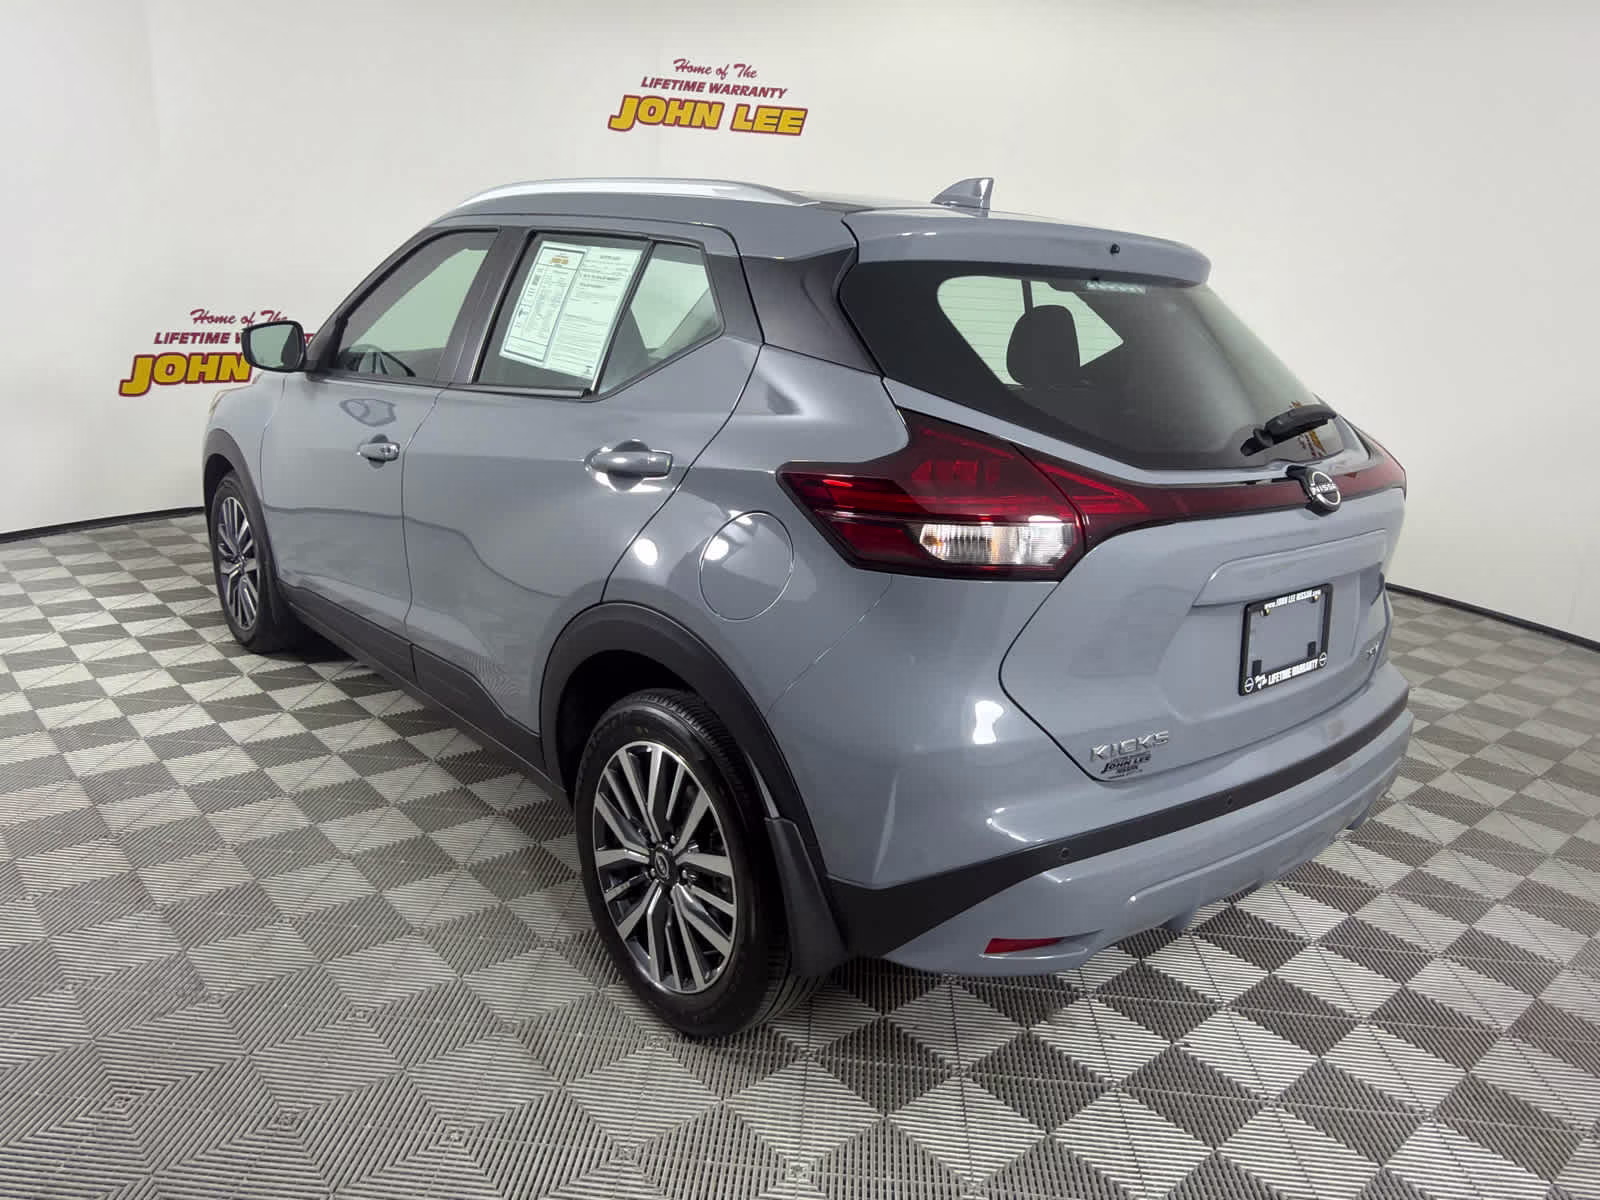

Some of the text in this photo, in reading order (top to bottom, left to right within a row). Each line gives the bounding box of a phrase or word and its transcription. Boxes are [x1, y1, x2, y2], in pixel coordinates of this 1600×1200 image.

[673, 58, 758, 80] Home of The
[640, 76, 788, 99] LIFETIME WARRANTY
[608, 95, 808, 136] JOHN LEE
[190, 308, 237, 325] Home
[240, 312, 256, 327] of
[153, 332, 231, 345] LIFETIME
[118, 352, 253, 397] JOHN
[1268, 667, 1292, 686] LIFETIME
[1090, 730, 1169, 762] KICKS
[1101, 758, 1132, 775] JOHN
